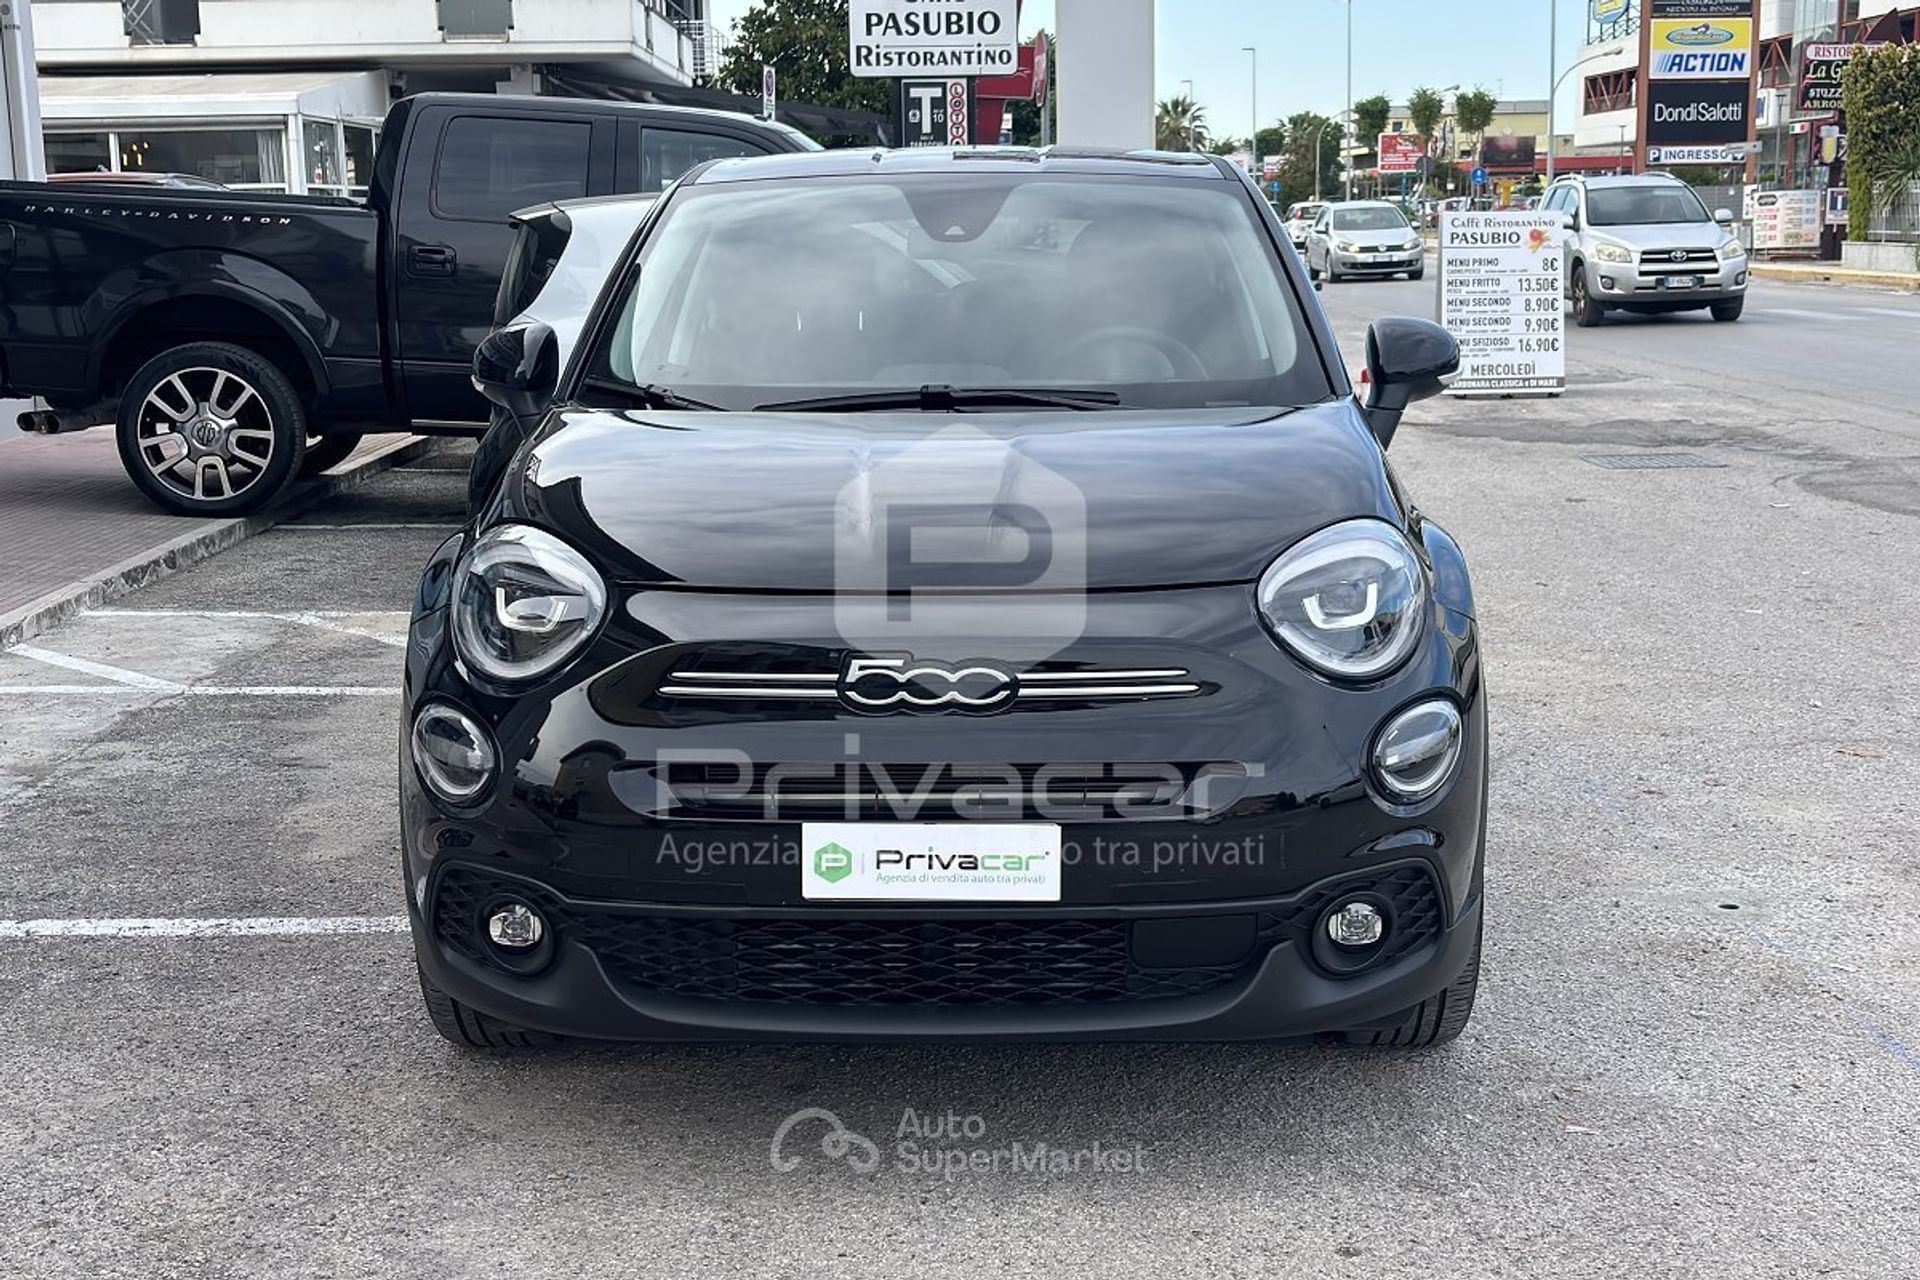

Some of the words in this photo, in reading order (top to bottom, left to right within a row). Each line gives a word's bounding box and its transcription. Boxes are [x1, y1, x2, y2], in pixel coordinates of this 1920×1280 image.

[866, 11, 1000, 36] PASUBIO
[856, 43, 1012, 66] RISTORANTINO
[1814, 46, 1853, 58] RISTOR
[1668, 53, 1745, 73] ACTION
[1806, 61, 1826, 79] La
[1808, 88, 1844, 98] STUZZ
[1804, 99, 1844, 109] ARROS
[932, 113, 945, 123] 10
[1664, 149, 1728, 160] INGRESSO
[1450, 232, 1521, 244] PASUBIO
[1447, 259, 1470, 267] MENU
[1472, 258, 1499, 267] PRIMO
[1542, 258, 1558, 271] 8€
[1447, 279, 1470, 288] MENU
[1472, 278, 1501, 288] FRITTO
[1518, 278, 1558, 292] 13.50€
[1447, 298, 1470, 307] MENU
[1472, 297, 1511, 307] SECONDO
[1524, 298, 1558, 312] 8.90€
[1447, 318, 1470, 326] MENU
[1472, 317, 1511, 326] SECONDO
[1524, 318, 1558, 332] 9.90€
[1472, 337, 1510, 346] SFIZIOSO
[1518, 338, 1559, 352] 16.90€
[1471, 360, 1536, 376] MERCOLEDÌ
[845, 658, 1011, 705] 500
[875, 846, 1046, 871] Privacar
[876, 873, 917, 884] Agenzia
[919, 872, 929, 882] di
[932, 872, 970, 883] vendita
[971, 874, 995, 883] auto
[997, 874, 1011, 883] tra
[1013, 873, 1046, 885] privati
